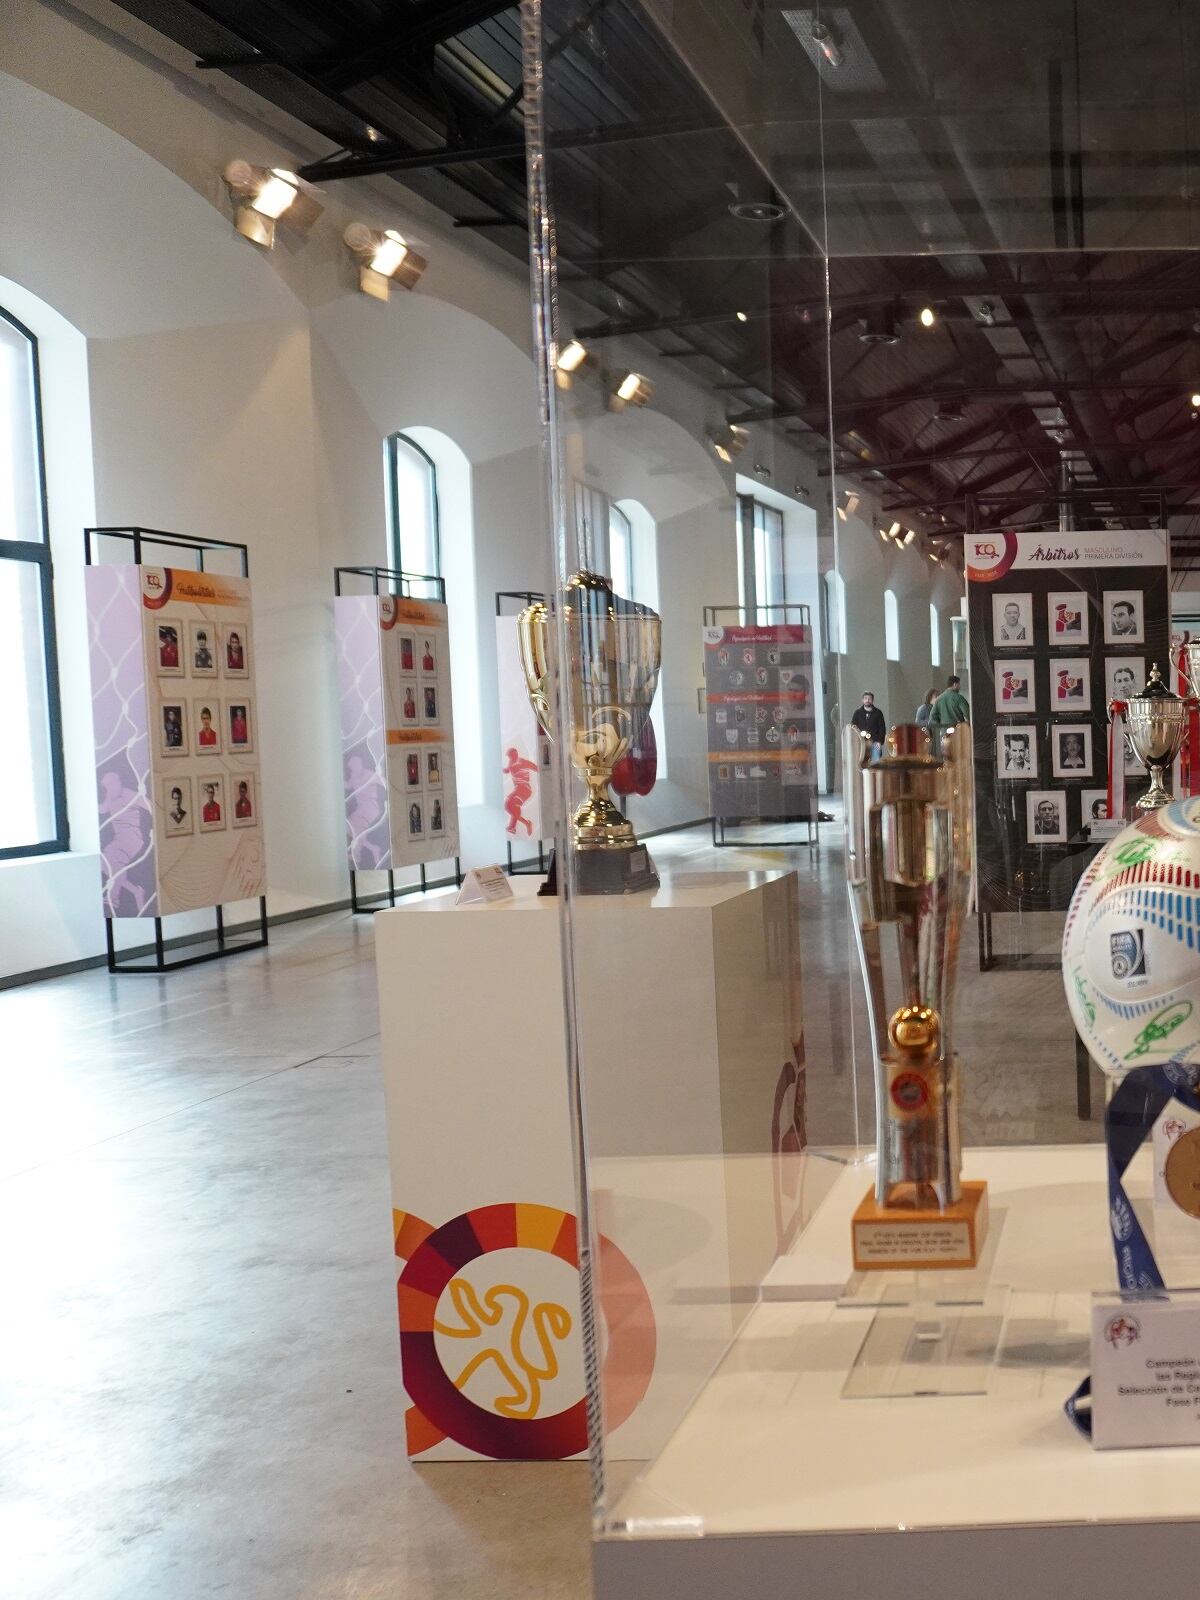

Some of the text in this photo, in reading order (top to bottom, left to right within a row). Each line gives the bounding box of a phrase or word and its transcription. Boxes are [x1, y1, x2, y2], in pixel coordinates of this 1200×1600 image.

[1028, 544, 1080, 561] Árbitros
[1115, 551, 1143, 559] DIVISIÓN
[1146, 1358, 1195, 1369] Campeón
[1171, 1384, 1183, 1393] de
[1166, 1397, 1191, 1407] Fase
